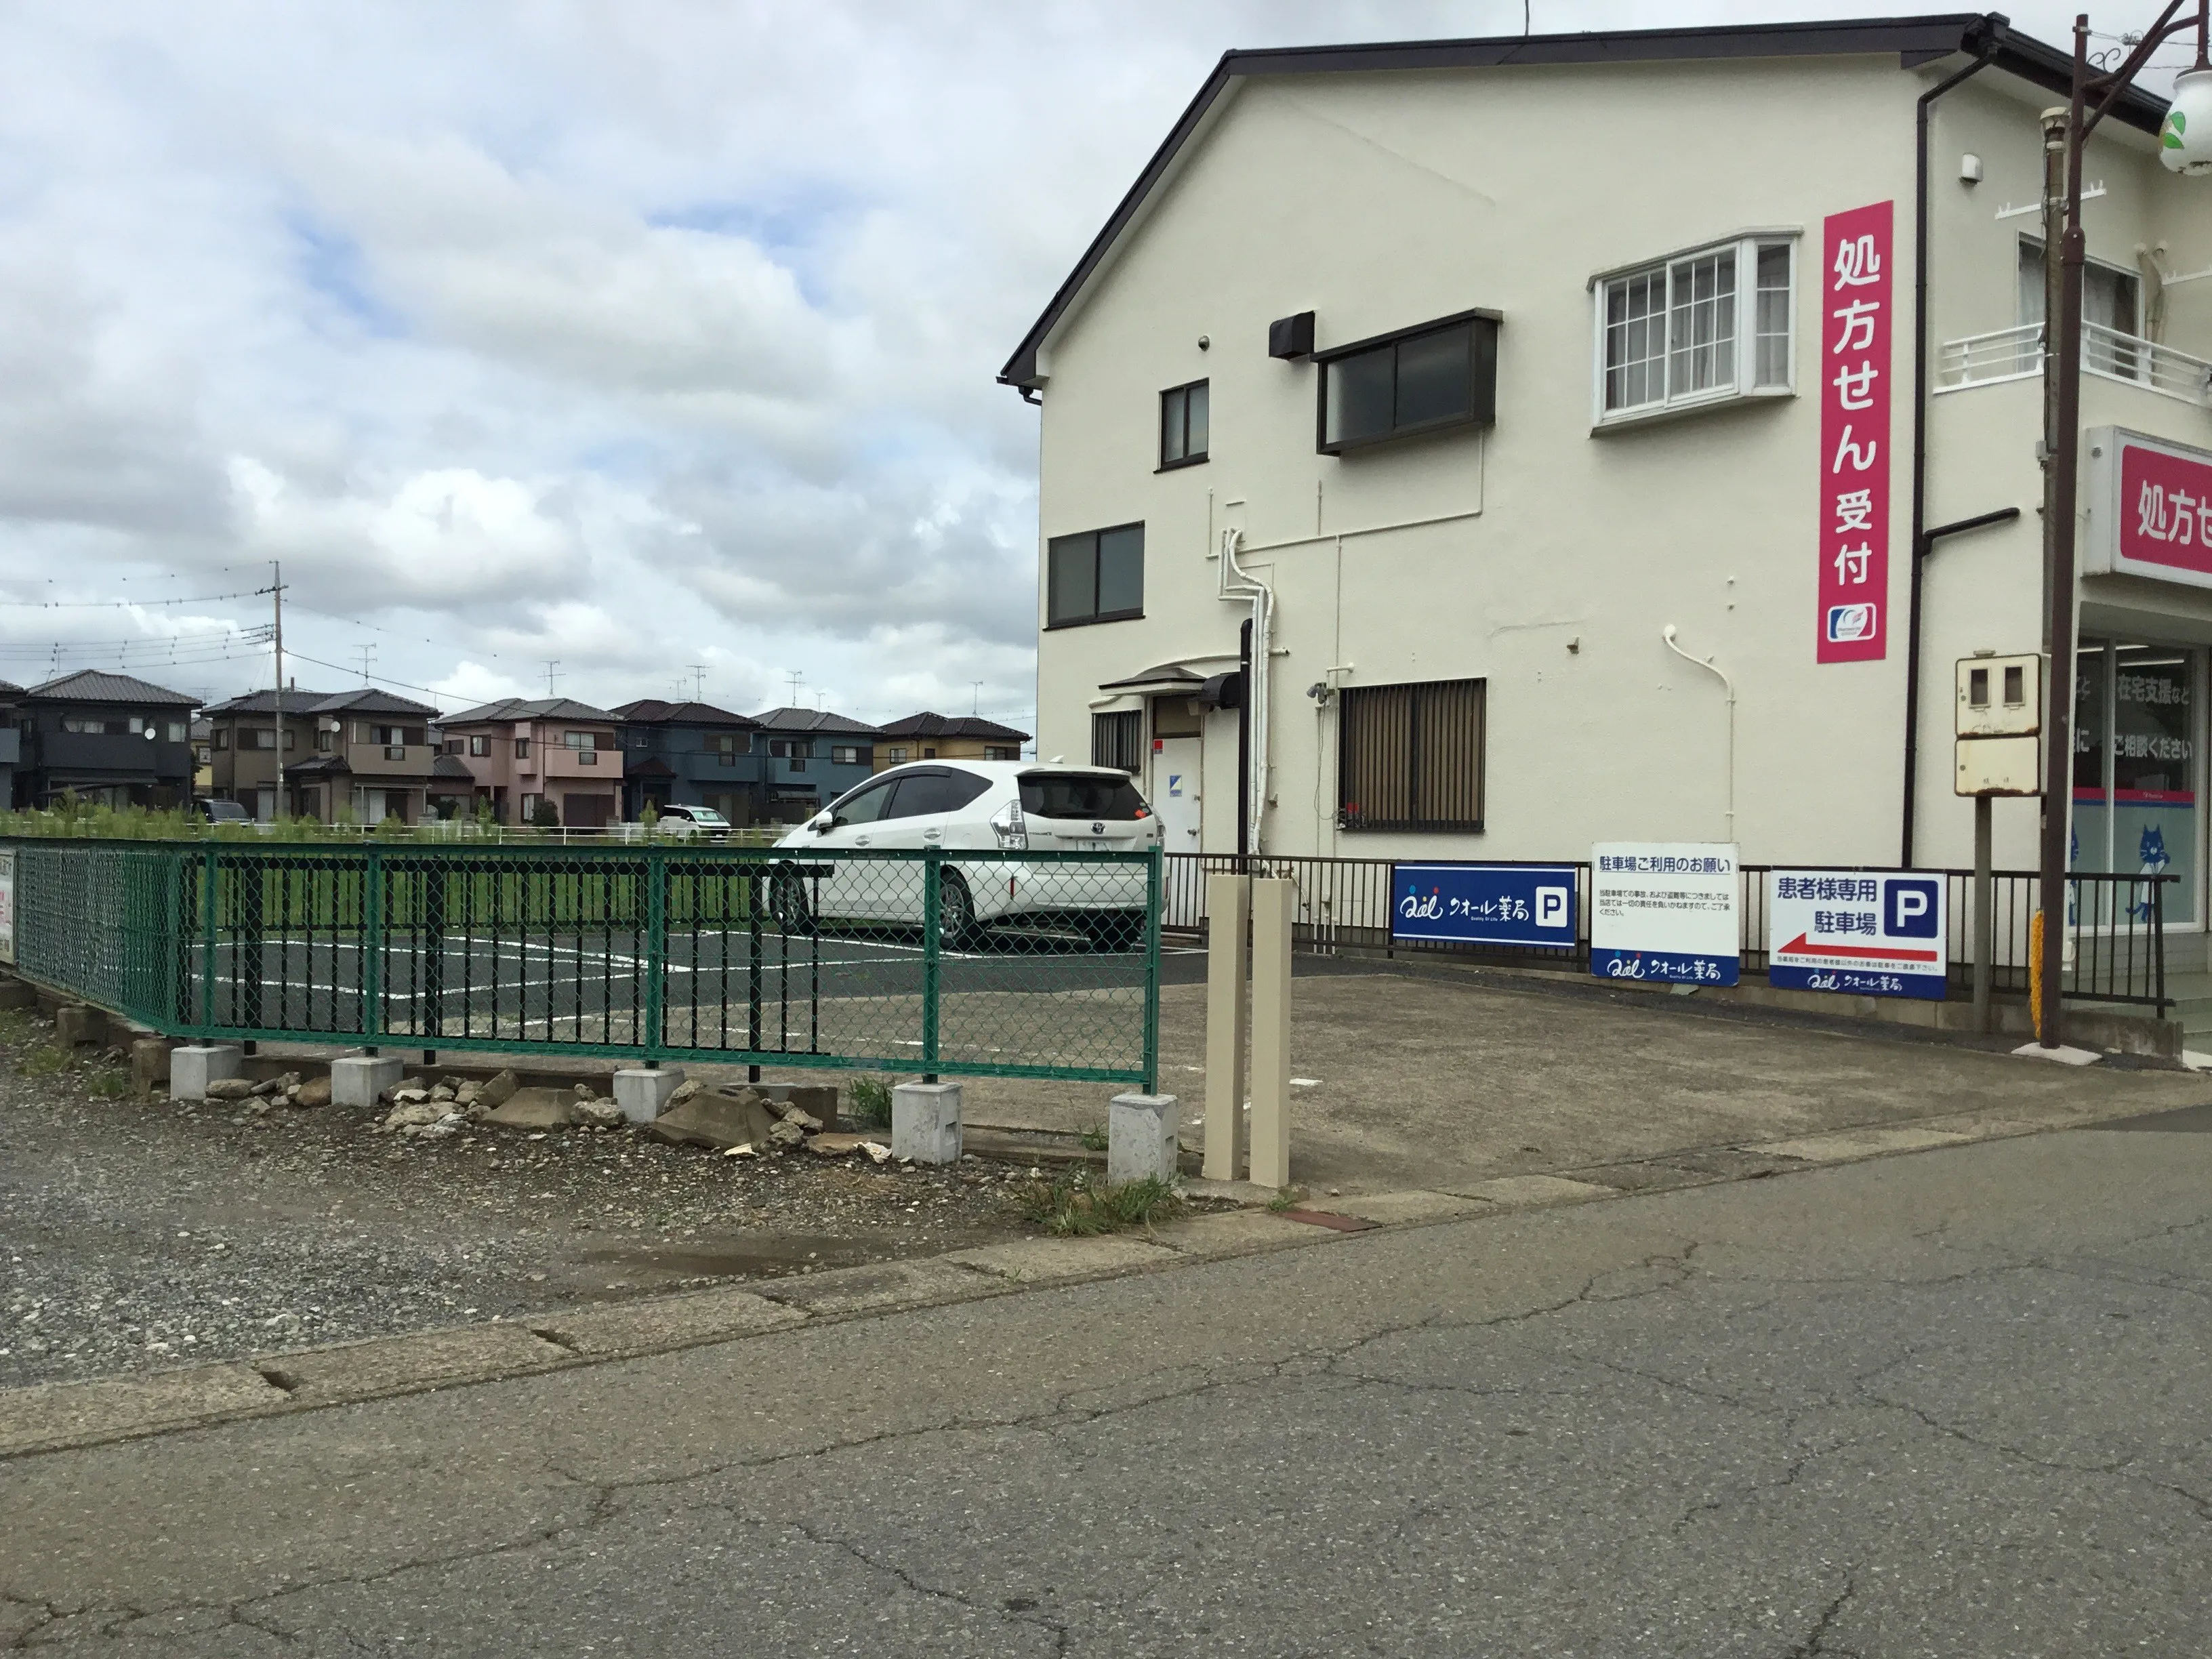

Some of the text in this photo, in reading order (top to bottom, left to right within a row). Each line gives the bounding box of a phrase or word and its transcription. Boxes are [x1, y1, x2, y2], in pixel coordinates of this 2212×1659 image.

[1833, 234, 1881, 586] 処方せん受付
[1599, 856, 1731, 873] 駐車場ご利用のお願い
[1778, 877, 1877, 902] 患者様専用
[1450, 895, 1530, 922] クオール薬局
[1543, 894, 1561, 920] P
[1897, 890, 1928, 927] P
[1814, 911, 1877, 935] 駐車場
[1650, 959, 1721, 981] クオール薬局
[1844, 975, 1902, 991] クオール薬局
